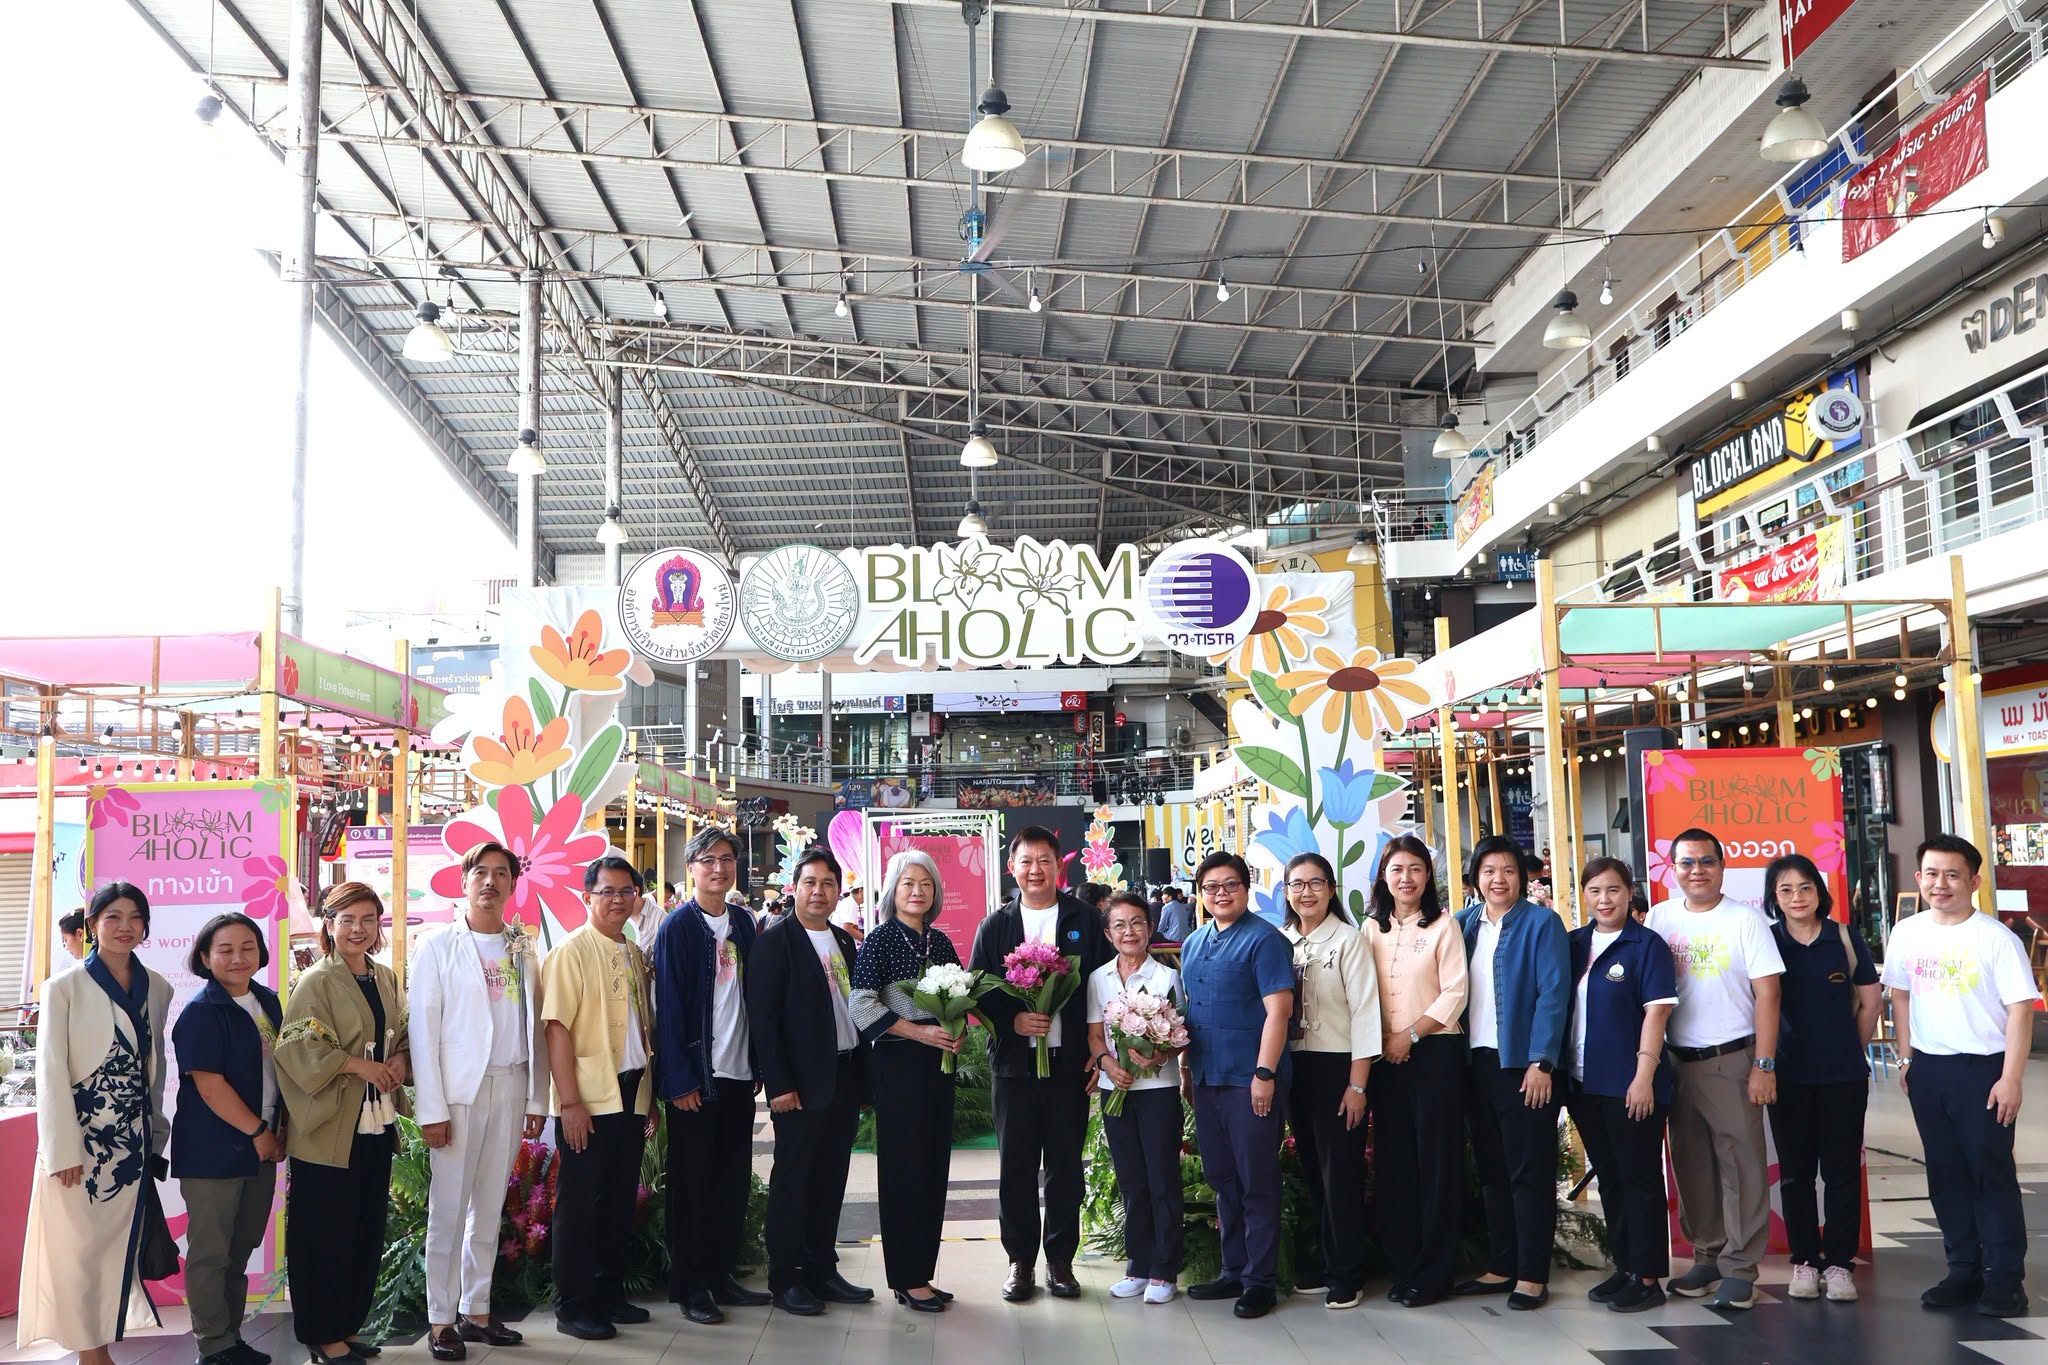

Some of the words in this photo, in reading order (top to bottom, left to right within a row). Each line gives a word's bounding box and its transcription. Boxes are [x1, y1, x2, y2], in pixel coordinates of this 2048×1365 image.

[1890, 132, 1927, 174] MUSIC
[1929, 92, 1977, 141] STUDIO
[1692, 416, 1784, 499] BLOCKLAND
[625, 584, 731, 659] องค์การบริหารส่วนจังหวัดเชียงใหม่
[860, 608, 1136, 660] AHOLIC
[1194, 633, 1235, 645] TISTR
[323, 678, 338, 693] Love
[1728, 703, 1858, 748] ABSUTE
[2001, 705, 2023, 727] นม
[2003, 734, 2019, 744] MILK
[2028, 730, 2048, 742] TOAS
[973, 778, 1002, 786] NARUTO
[1688, 802, 1808, 825] AHOLIC
[129, 836, 253, 861] AHOLIC
[148, 868, 233, 896] ทางเข้า
